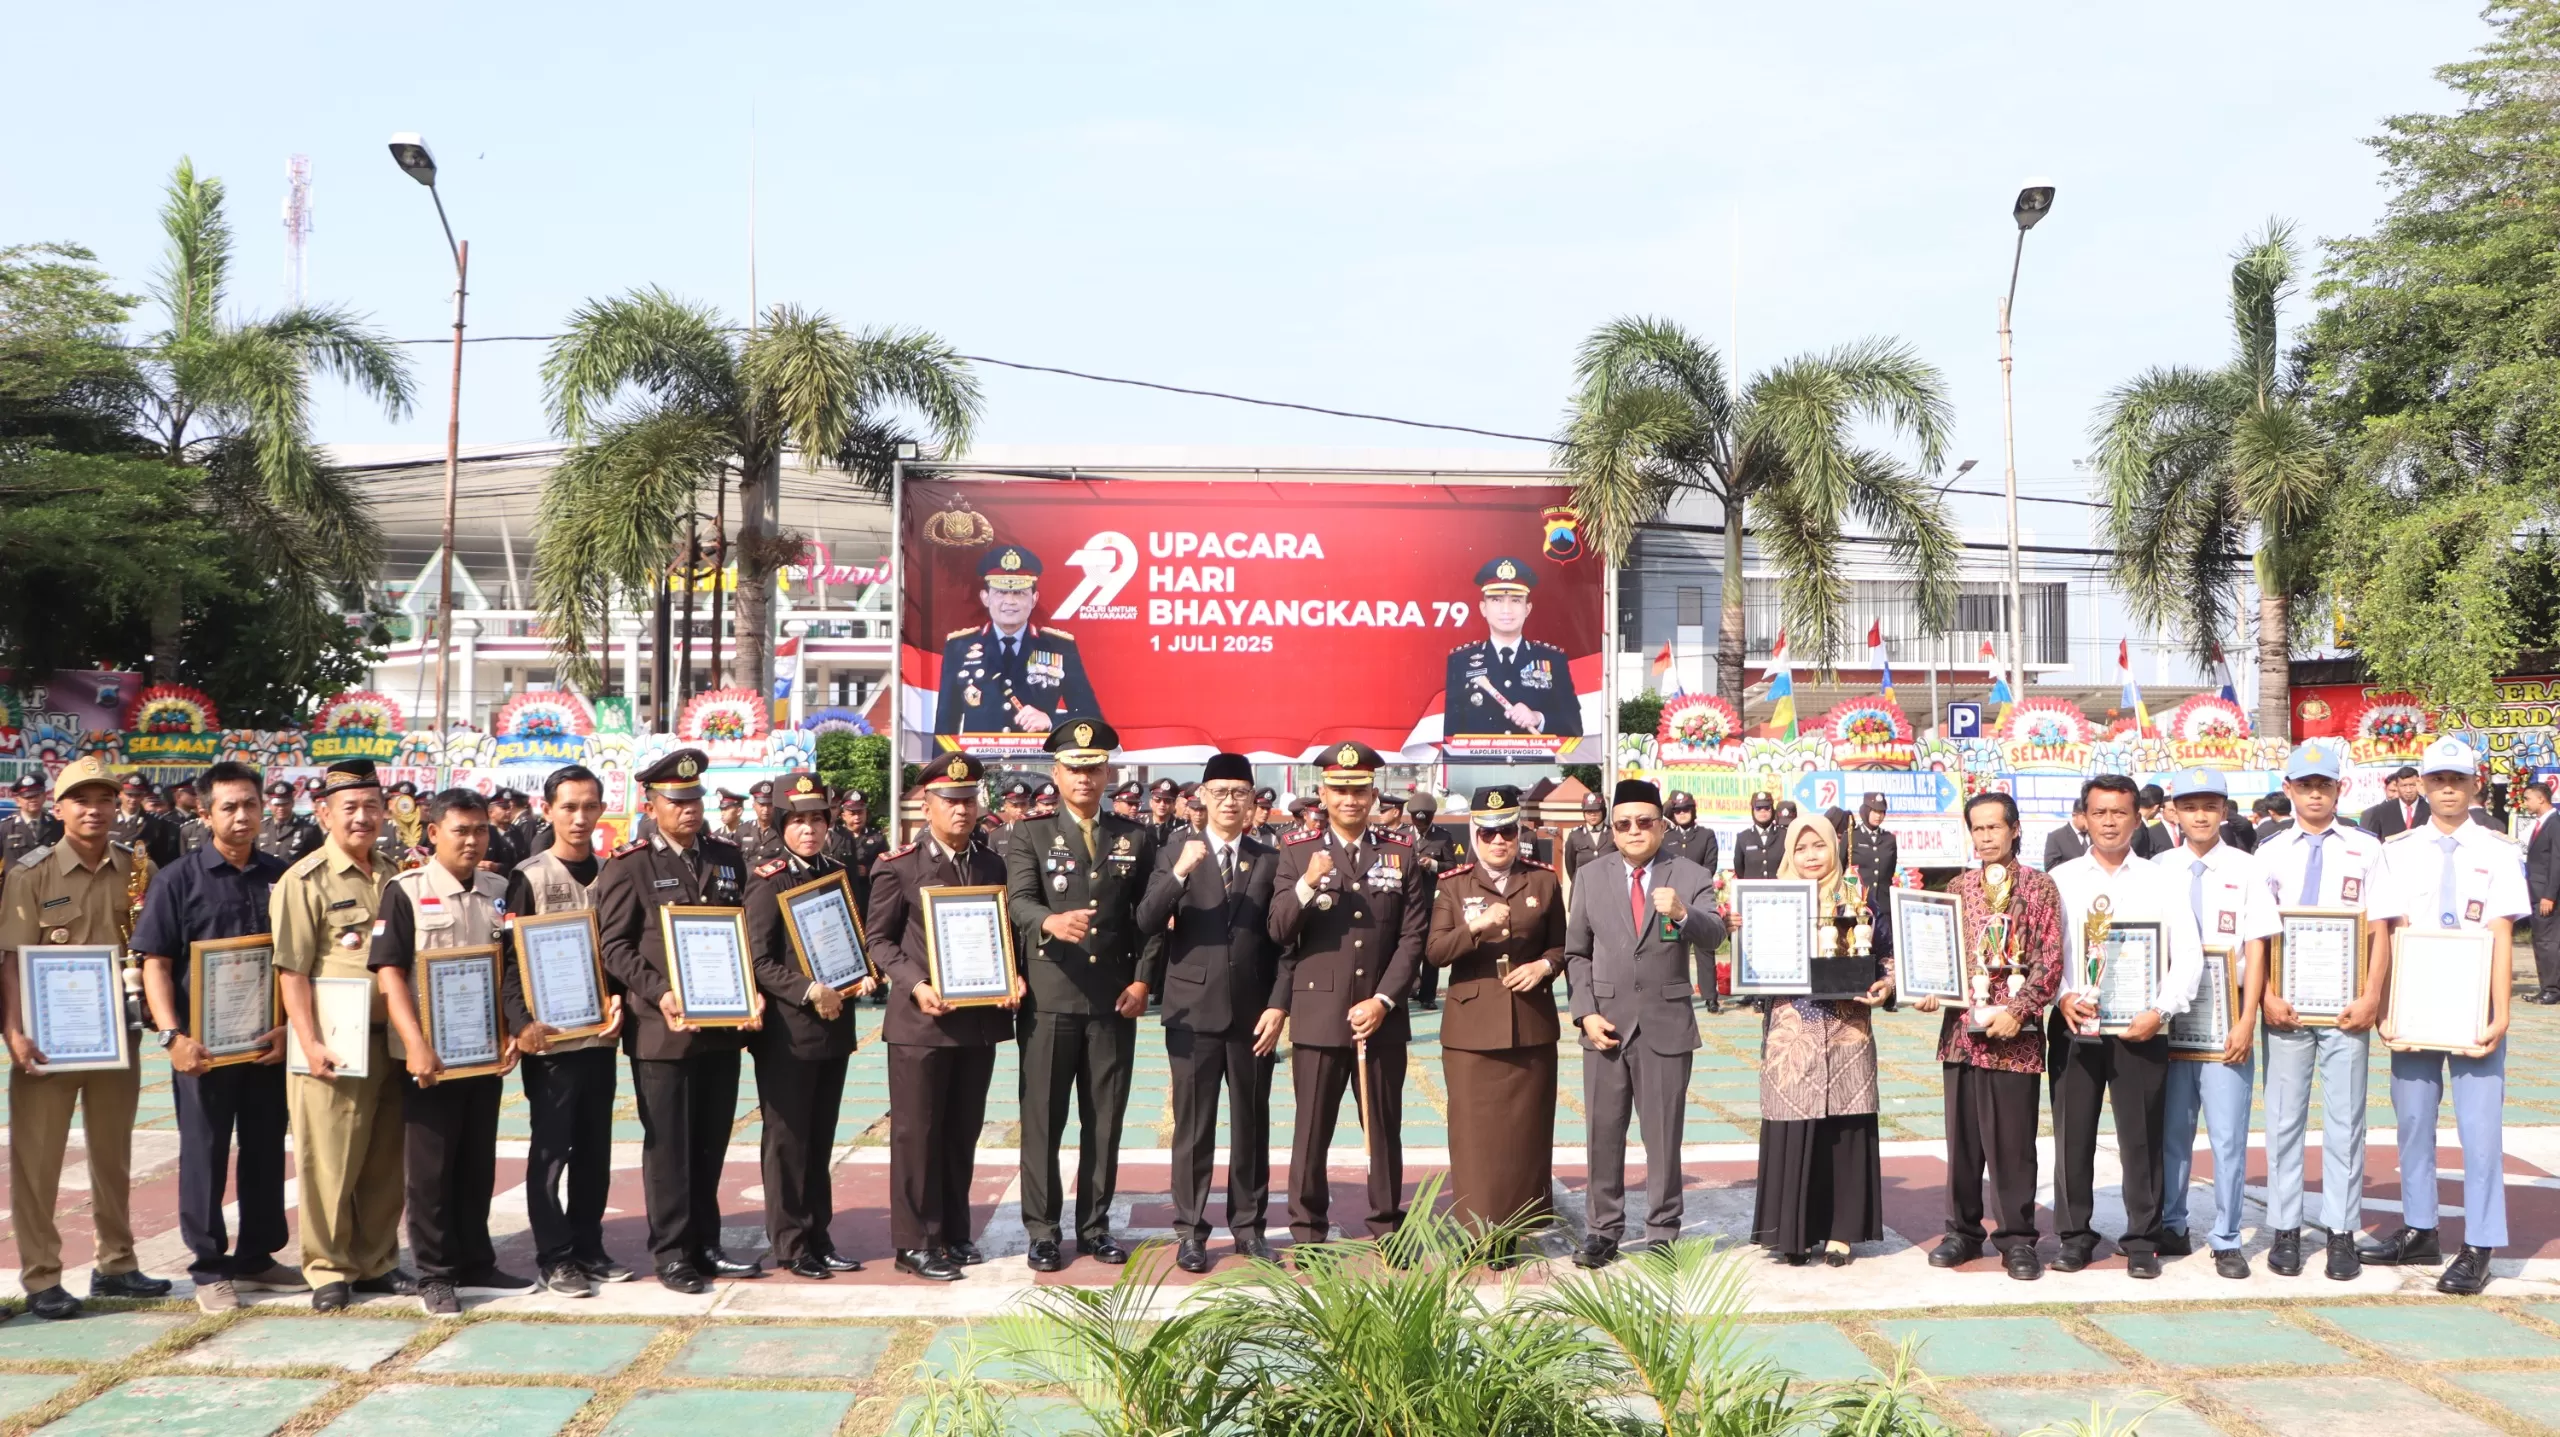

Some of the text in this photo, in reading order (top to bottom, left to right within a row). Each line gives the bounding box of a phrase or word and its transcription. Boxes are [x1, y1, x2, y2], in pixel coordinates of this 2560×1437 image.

[1149, 531, 1324, 559] UPACARA
[1149, 566, 1235, 592] HARI
[1079, 605, 1138, 613] POLRI UNTUK
[1149, 599, 1469, 628] BHAYANGKARA 79
[1150, 635, 1273, 652] 1 JULI 2025
[1954, 709, 1975, 734] P
[128, 737, 218, 754] SELAMAT
[311, 737, 397, 757] SELAMAT
[495, 740, 584, 760] SELAMAT
[1661, 743, 1743, 764] SELAMAT
[1835, 742, 1914, 761] SELAMAT
[2011, 745, 2087, 765] SELAMAT
[2176, 743, 2248, 761] SELAMAT
[1918, 831, 1943, 850] DAYA
